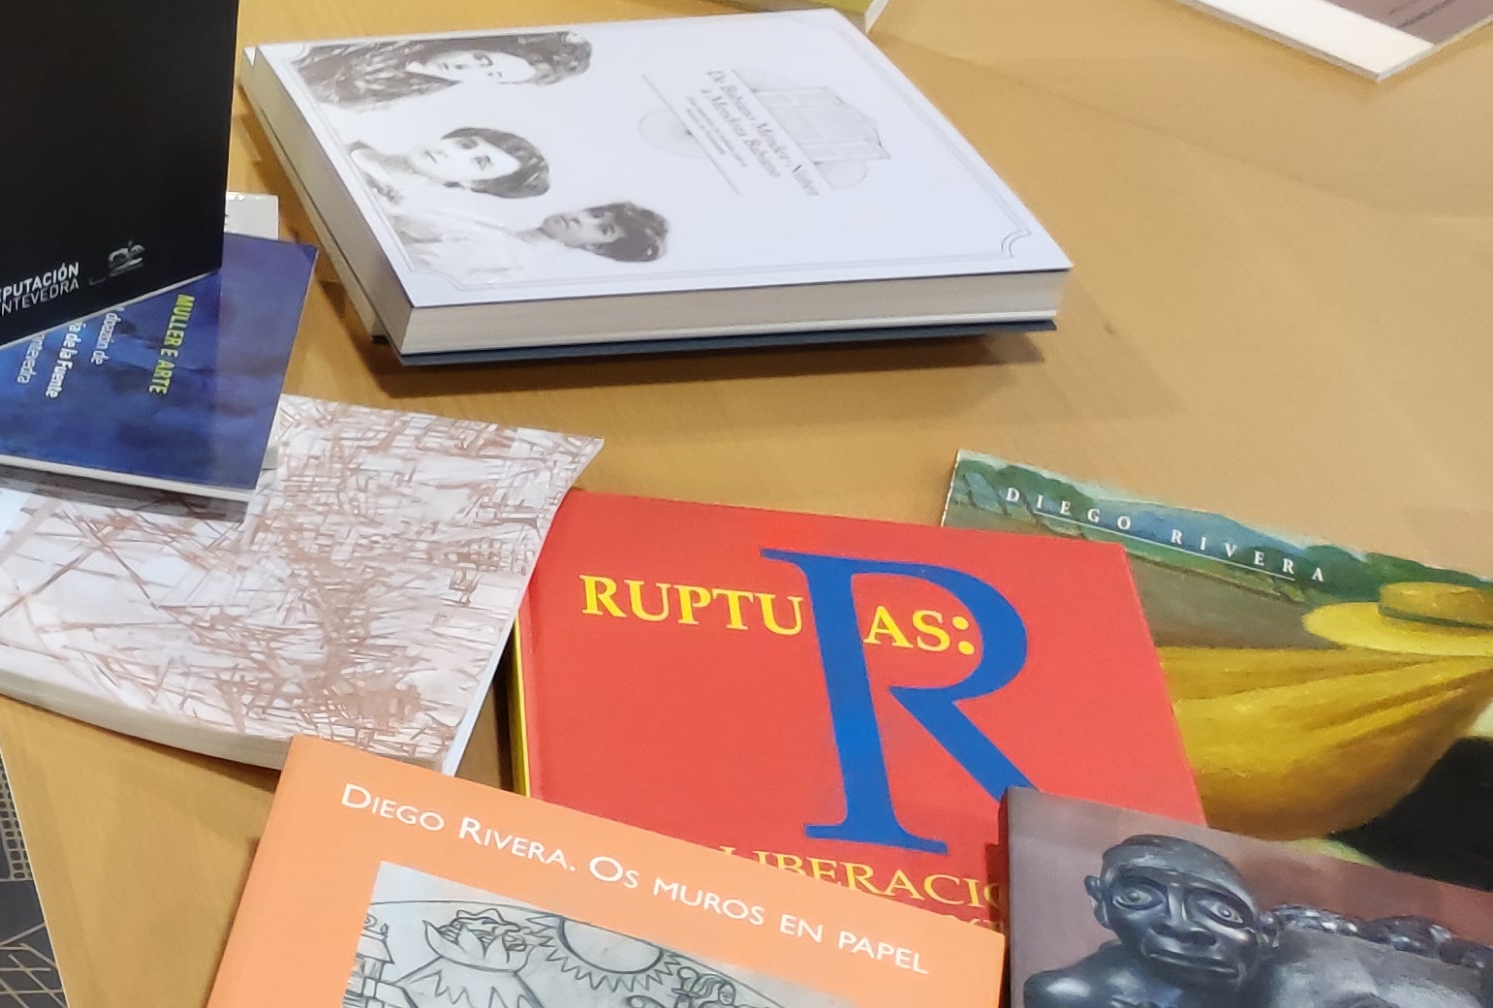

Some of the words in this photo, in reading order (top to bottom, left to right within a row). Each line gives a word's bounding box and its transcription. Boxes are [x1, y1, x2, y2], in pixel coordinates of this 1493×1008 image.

[96, 313, 121, 349] doazón
[164, 294, 195, 350] MULLER
[59, 348, 78, 359] la
[63, 333, 82, 348] de
[91, 350, 109, 366] de
[161, 349, 179, 358] E
[45, 359, 73, 398] Fuente
[148, 359, 176, 395] ARTE
[1005, 487, 1131, 531] DIEGO
[1171, 528, 1324, 583] RIVERA
[779, 913, 824, 944] EN
[837, 930, 929, 975] PAPEL
